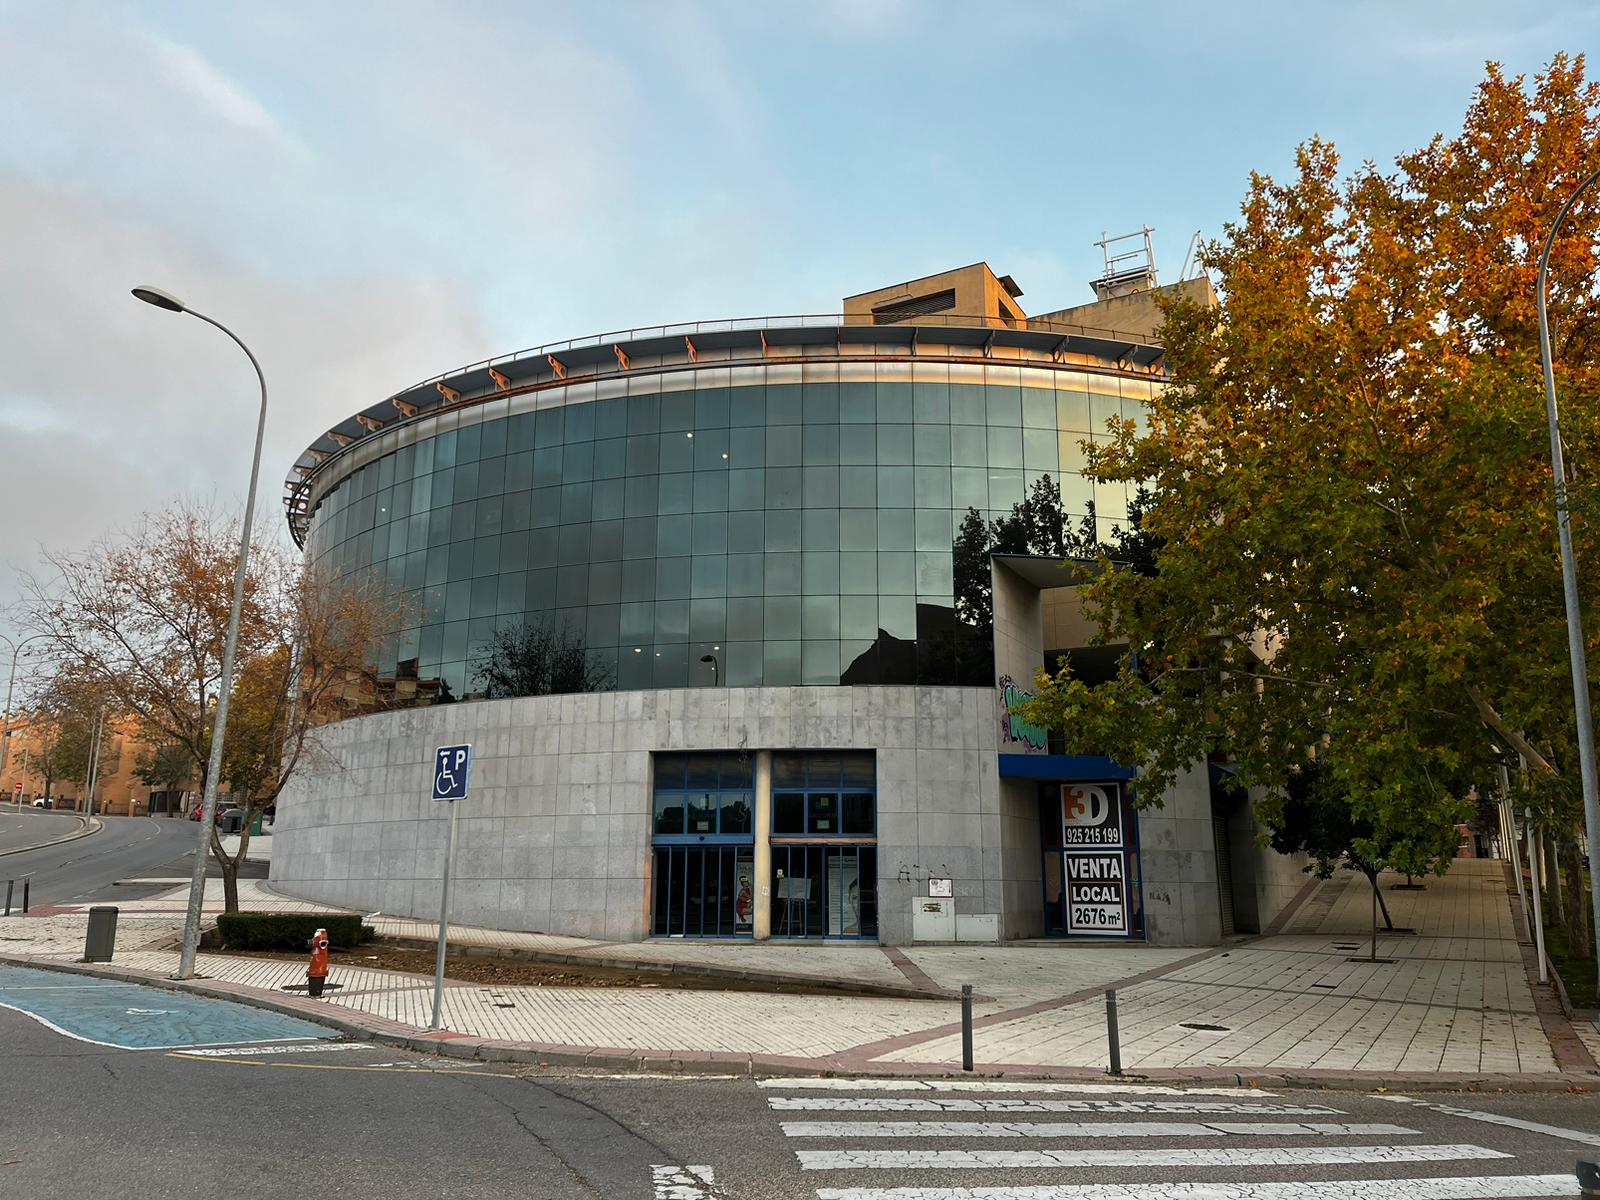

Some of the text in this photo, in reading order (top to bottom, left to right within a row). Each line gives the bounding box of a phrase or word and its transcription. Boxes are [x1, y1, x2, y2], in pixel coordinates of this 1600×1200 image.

[455, 750, 466, 770] P
[1068, 785, 1109, 826] 3D
[1067, 828, 1119, 843] 925 215 199
[1068, 858, 1121, 879] VENTA
[1072, 886, 1120, 902] LOCAL
[1075, 908, 1107, 925] 2676
